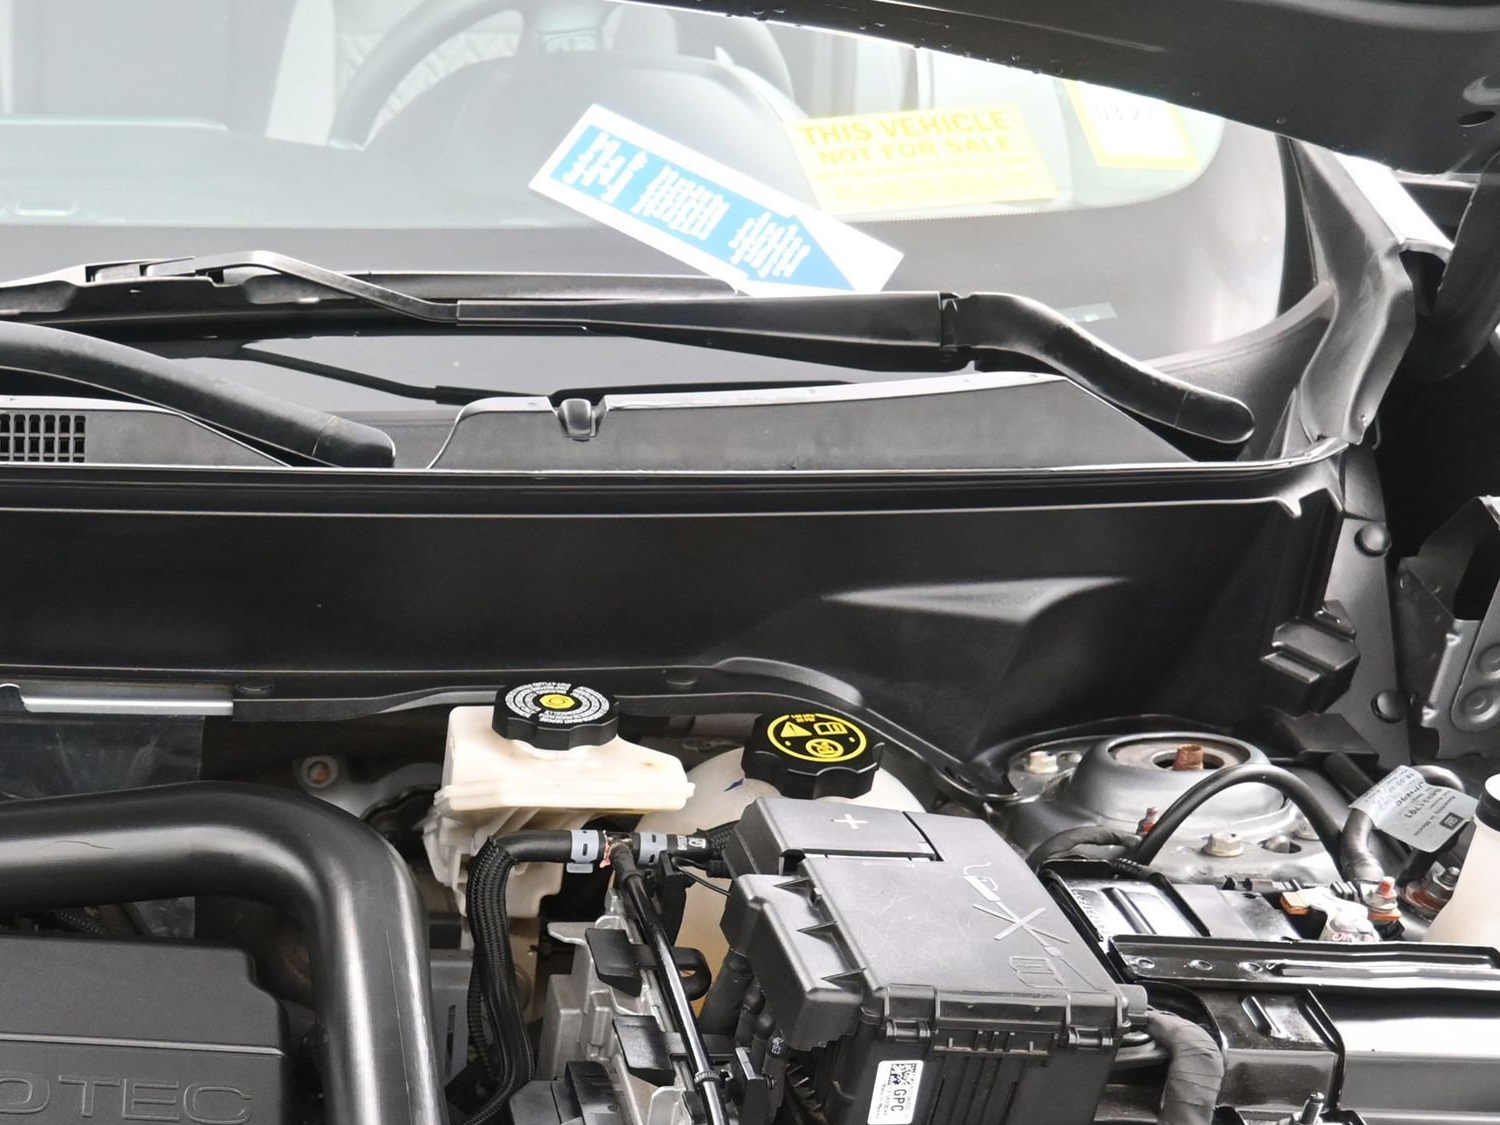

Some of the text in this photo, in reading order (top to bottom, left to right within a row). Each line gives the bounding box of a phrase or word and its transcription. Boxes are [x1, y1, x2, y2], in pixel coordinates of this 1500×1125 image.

[801, 110, 1013, 147] THIS VEHICLE
[818, 135, 1013, 168] NOT FOR SALE
[890, 1088, 907, 1112] GPC
